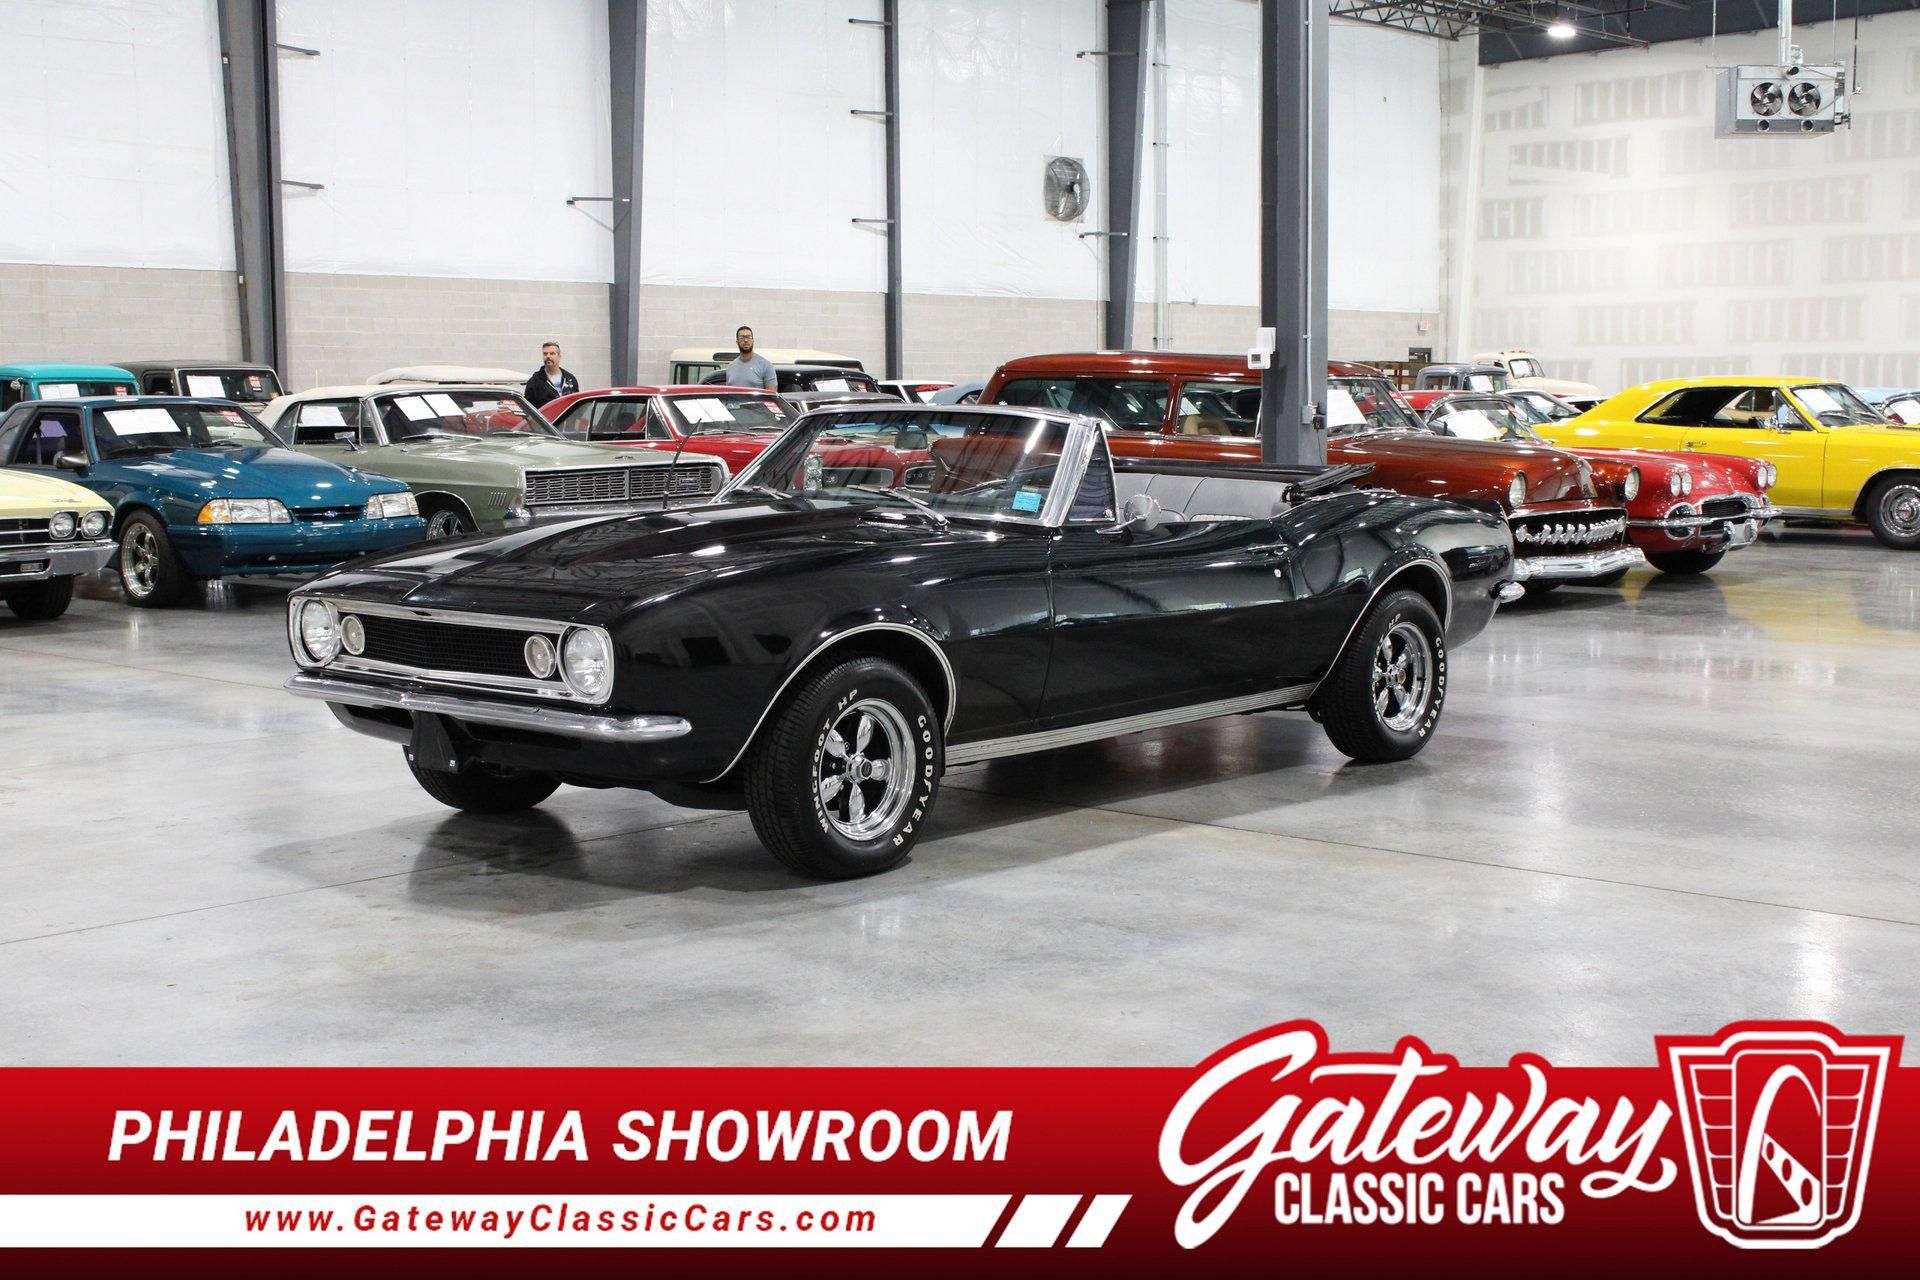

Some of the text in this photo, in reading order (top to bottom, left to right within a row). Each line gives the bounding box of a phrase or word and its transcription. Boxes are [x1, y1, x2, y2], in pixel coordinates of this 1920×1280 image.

[1418, 636, 1446, 738] GOODYEAR
[811, 688, 859, 834] WINGFOOT HP
[892, 714, 935, 847] GOODYEAR
